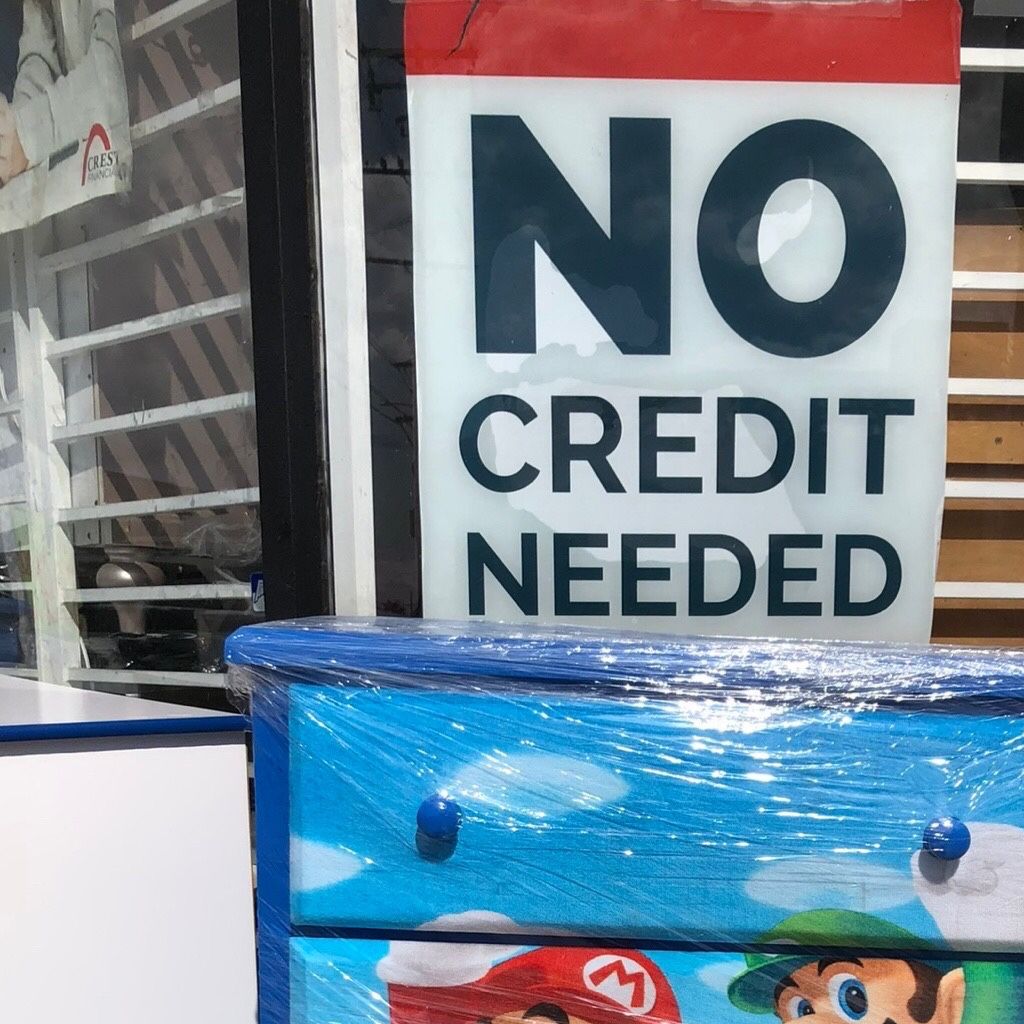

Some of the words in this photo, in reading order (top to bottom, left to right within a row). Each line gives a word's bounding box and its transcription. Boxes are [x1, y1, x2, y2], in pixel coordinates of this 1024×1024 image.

[471, 114, 906, 358] NO
[459, 394, 915, 495] CREDIT
[467, 531, 902, 617] NEEDED
[588, 959, 646, 1009] M
